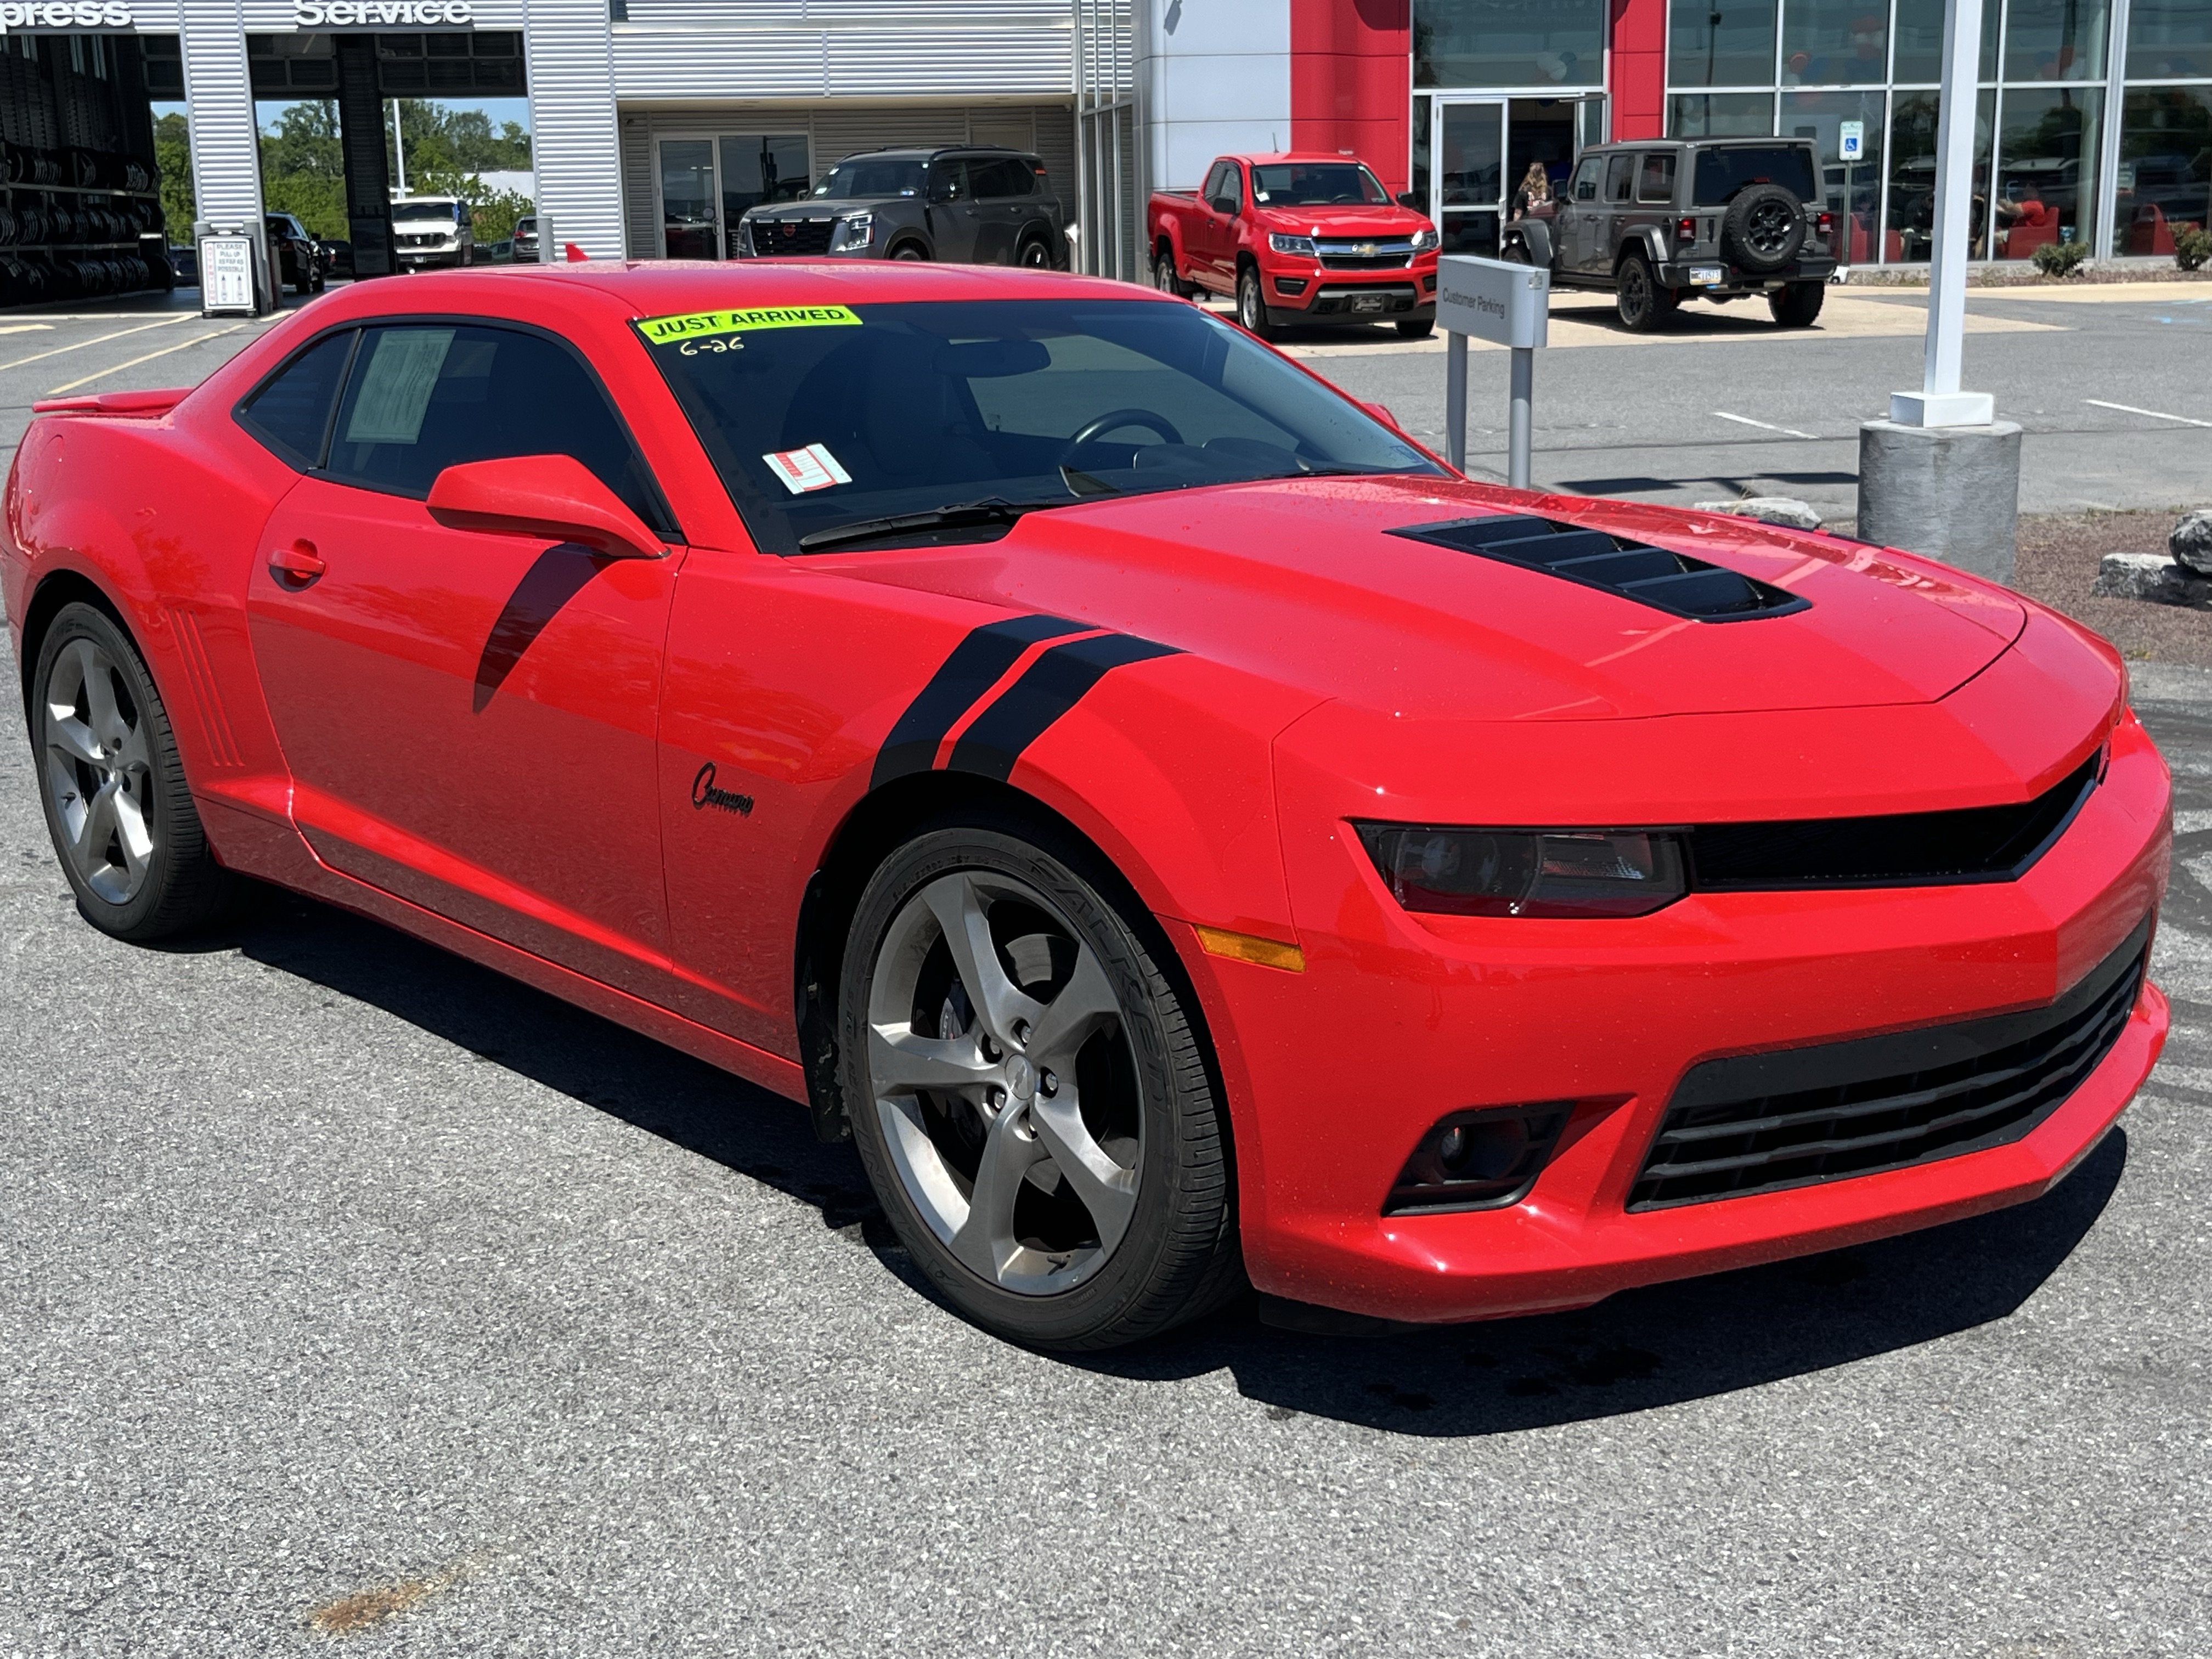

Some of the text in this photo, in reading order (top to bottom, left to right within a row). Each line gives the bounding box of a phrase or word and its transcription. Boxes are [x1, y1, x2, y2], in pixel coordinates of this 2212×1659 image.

[294, 0, 472, 25] Service
[1442, 287, 1505, 320] Customer Parking
[653, 309, 848, 337] JUST ARRIVED
[680, 336, 744, 356] 6-26
